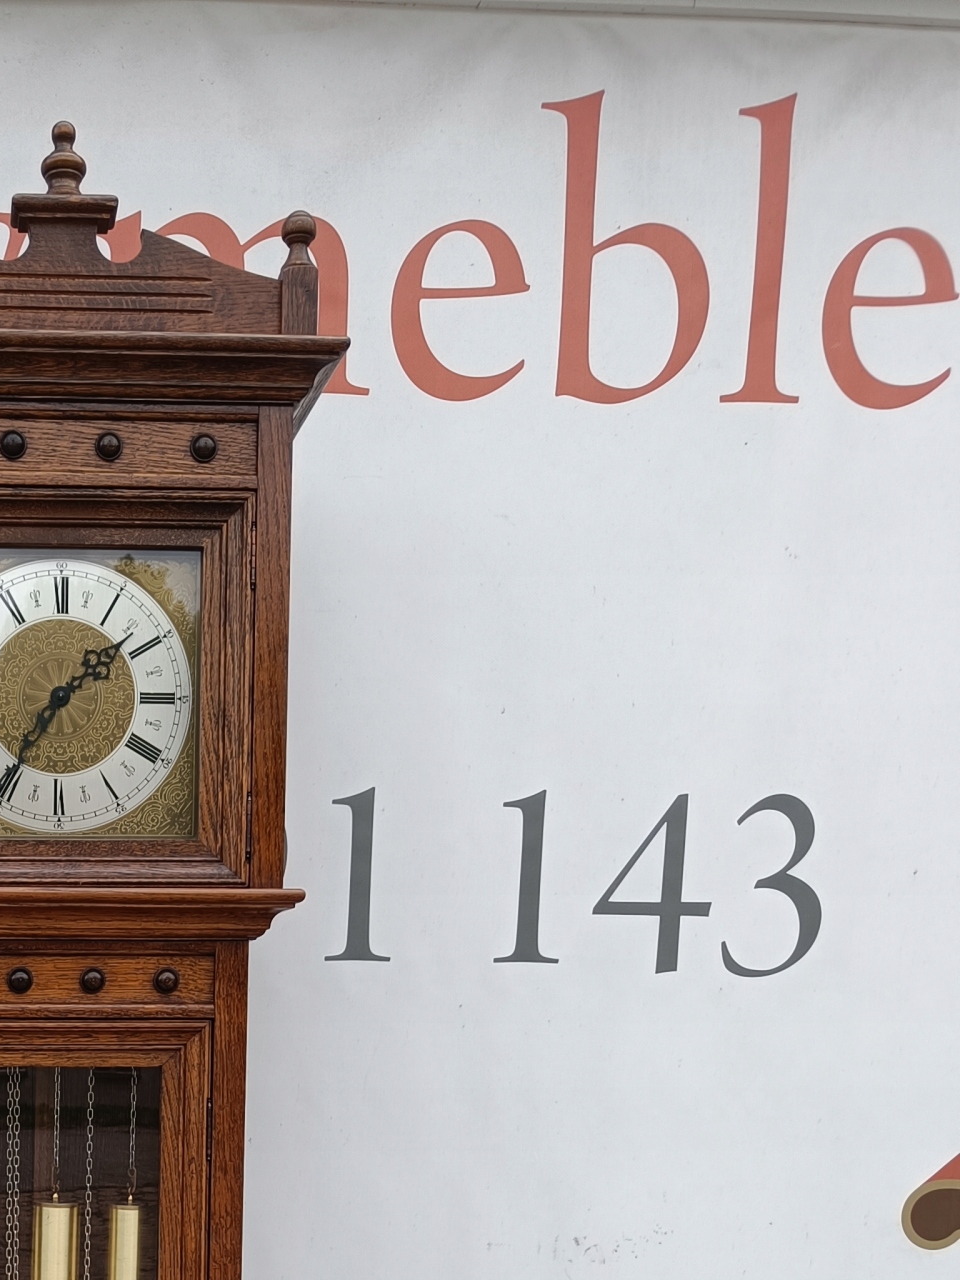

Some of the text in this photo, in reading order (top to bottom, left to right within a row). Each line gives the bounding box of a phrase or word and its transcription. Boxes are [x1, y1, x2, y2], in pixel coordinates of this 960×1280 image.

[56, 561, 68, 570] 60
[52, 576, 69, 615] XII
[120, 580, 128, 588] 5
[100, 592, 120, 627] I
[128, 635, 162, 660] II
[139, 691, 175, 705] III
[181, 694, 189, 704] 15
[124, 732, 162, 764] IIII
[162, 757, 173, 769] 20
[53, 778, 66, 816] VI
[98, 768, 120, 803] V
[493, 790, 821, 978] 143
